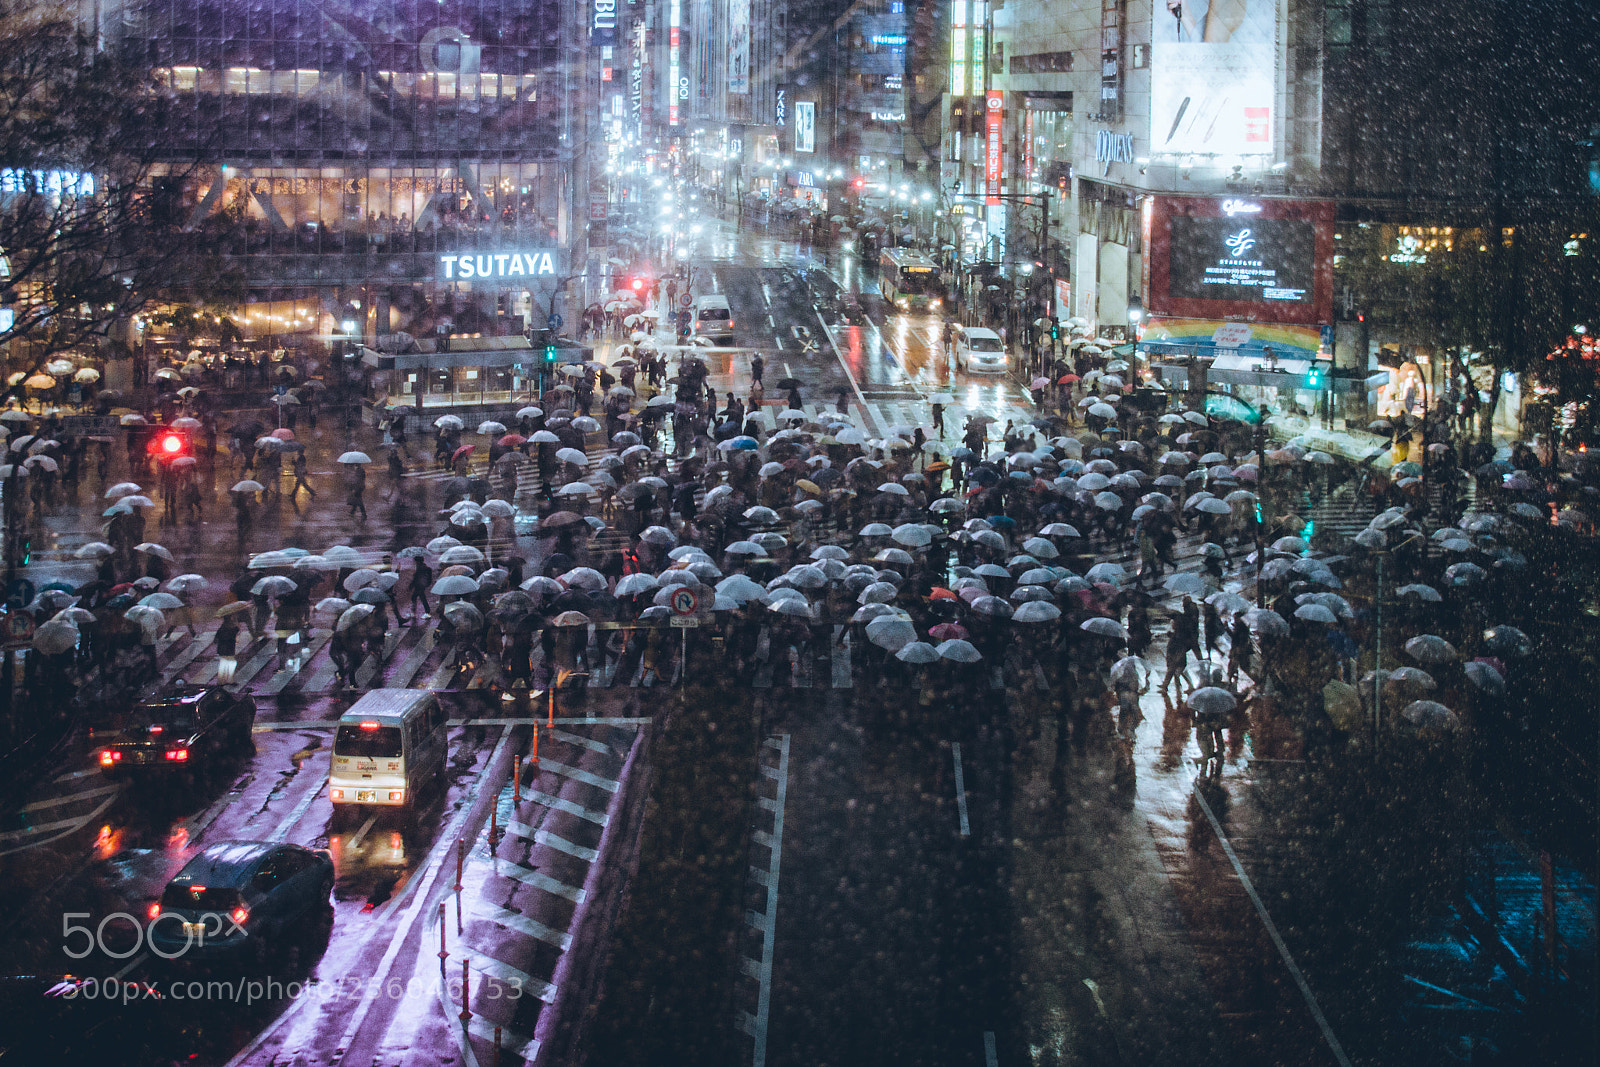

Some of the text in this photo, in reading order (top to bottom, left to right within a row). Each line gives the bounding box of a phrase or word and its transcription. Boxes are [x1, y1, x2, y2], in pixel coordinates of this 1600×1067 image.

[776, 90, 785, 126] ZARA
[227, 177, 464, 194] STARBUCKS COFFEE
[798, 171, 814, 187] ZARA
[441, 253, 555, 279] TSUTAYA
